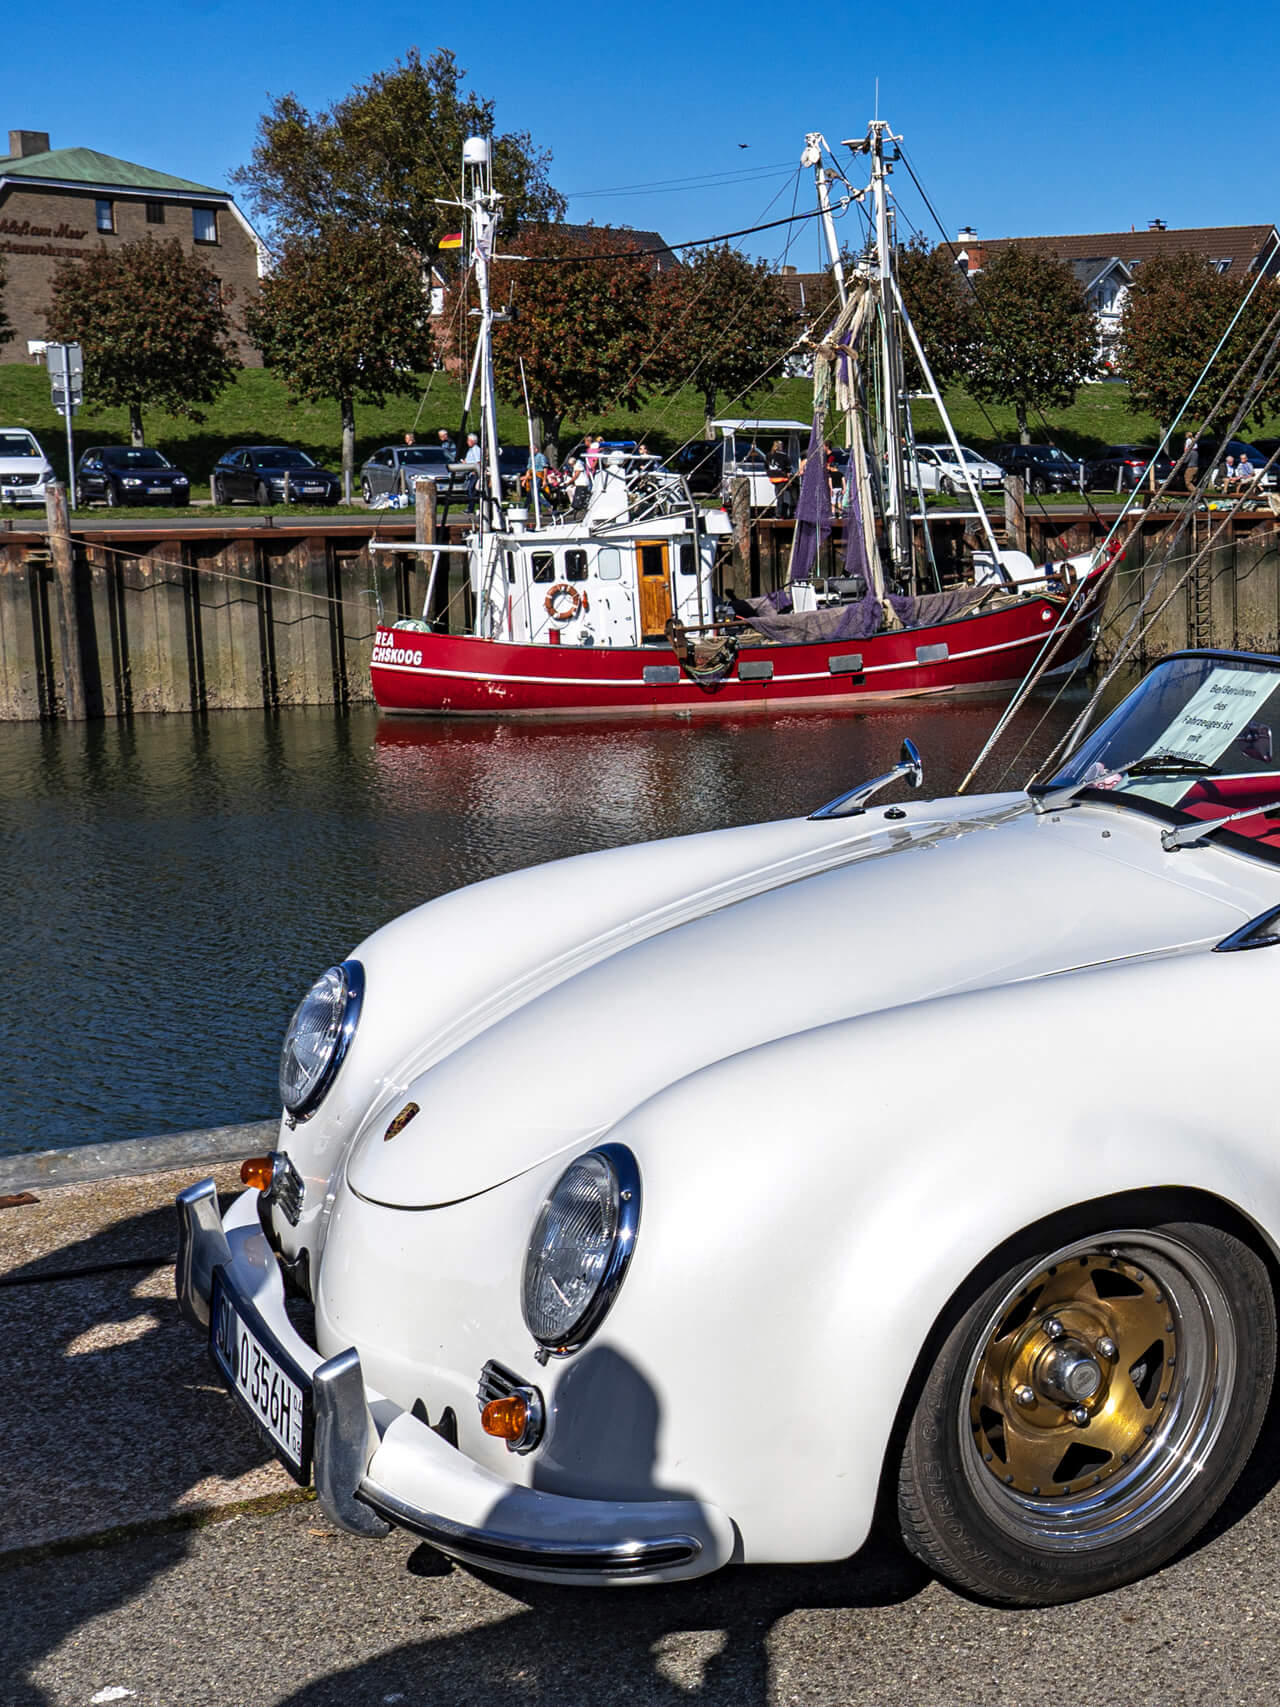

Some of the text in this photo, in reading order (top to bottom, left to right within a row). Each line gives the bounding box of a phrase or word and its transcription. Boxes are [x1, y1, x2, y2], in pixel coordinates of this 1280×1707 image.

[30, 226, 52, 237] am
[53, 222, 89, 240] Meer
[374, 631, 394, 648] REA
[372, 647, 422, 665] CHSKOOG
[1210, 684, 1222, 693] Bei
[1213, 701, 1228, 710] des
[1183, 715, 1234, 731] Fahrzeuges ist
[1187, 733, 1202, 743] mit
[251, 1343, 292, 1446] 356H
